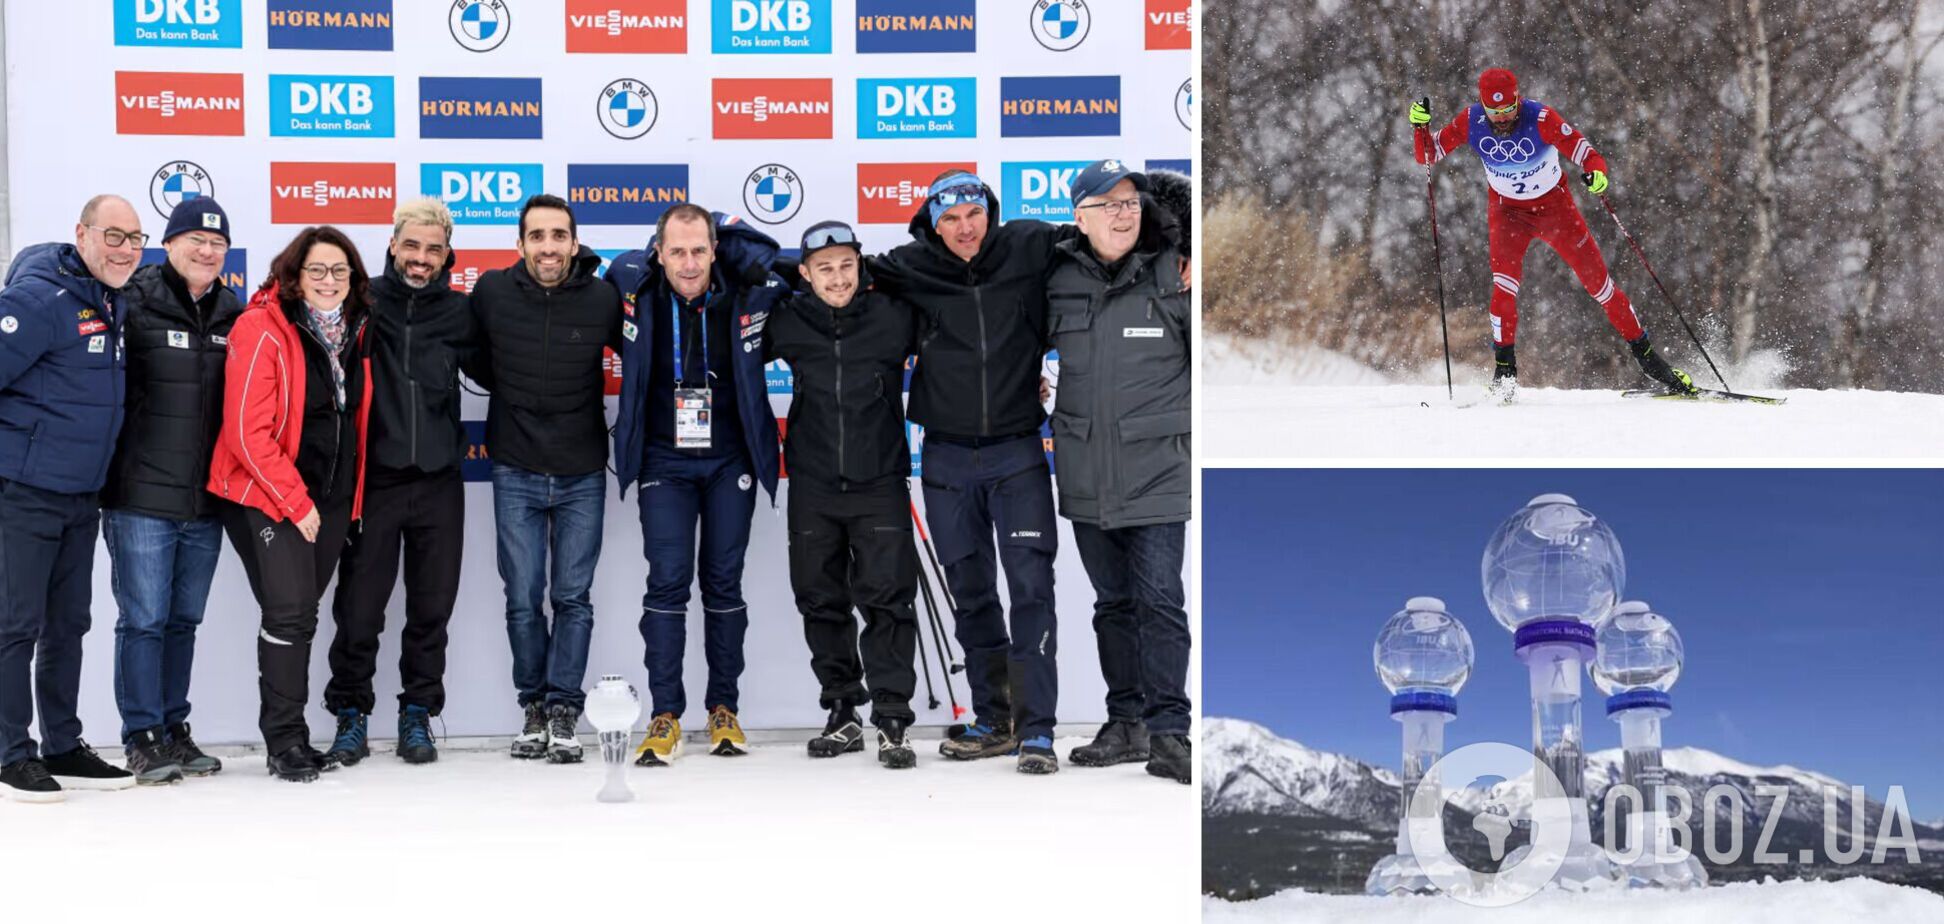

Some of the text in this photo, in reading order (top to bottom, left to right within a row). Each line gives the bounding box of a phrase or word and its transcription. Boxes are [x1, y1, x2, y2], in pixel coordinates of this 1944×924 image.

[135, 0, 220, 25] DKB
[270, 10, 390, 27] HÖRMANN
[731, 0, 812, 32] DKB
[570, 9, 684, 36] VIESSMANN
[859, 14, 973, 31] HÖRMANN
[136, 27, 218, 40] Das kann Bank
[732, 35, 809, 47] Das kann Bank
[605, 81, 650, 99] BMW
[120, 90, 240, 117] VIESSMANN
[290, 83, 373, 115] DKB
[422, 99, 539, 116] HÖRMANN
[877, 85, 956, 117] DKB
[1003, 98, 1118, 115] HÖRMANN
[717, 96, 830, 122] VIESSMANN
[291, 118, 371, 131] Das kann Bank
[877, 120, 954, 132] Das kann Bank
[159, 164, 205, 181] BMW
[751, 167, 795, 183] BMW
[441, 170, 522, 203] DKB
[1021, 168, 1084, 200] DK
[1512, 182, 1526, 194] 2
[275, 180, 392, 207] VIESSMANN
[571, 186, 686, 203] HÖRMANN
[863, 180, 928, 206] VIESSM
[449, 207, 462, 218] as
[465, 206, 491, 218] kann
[1021, 203, 1070, 215] Das kann
